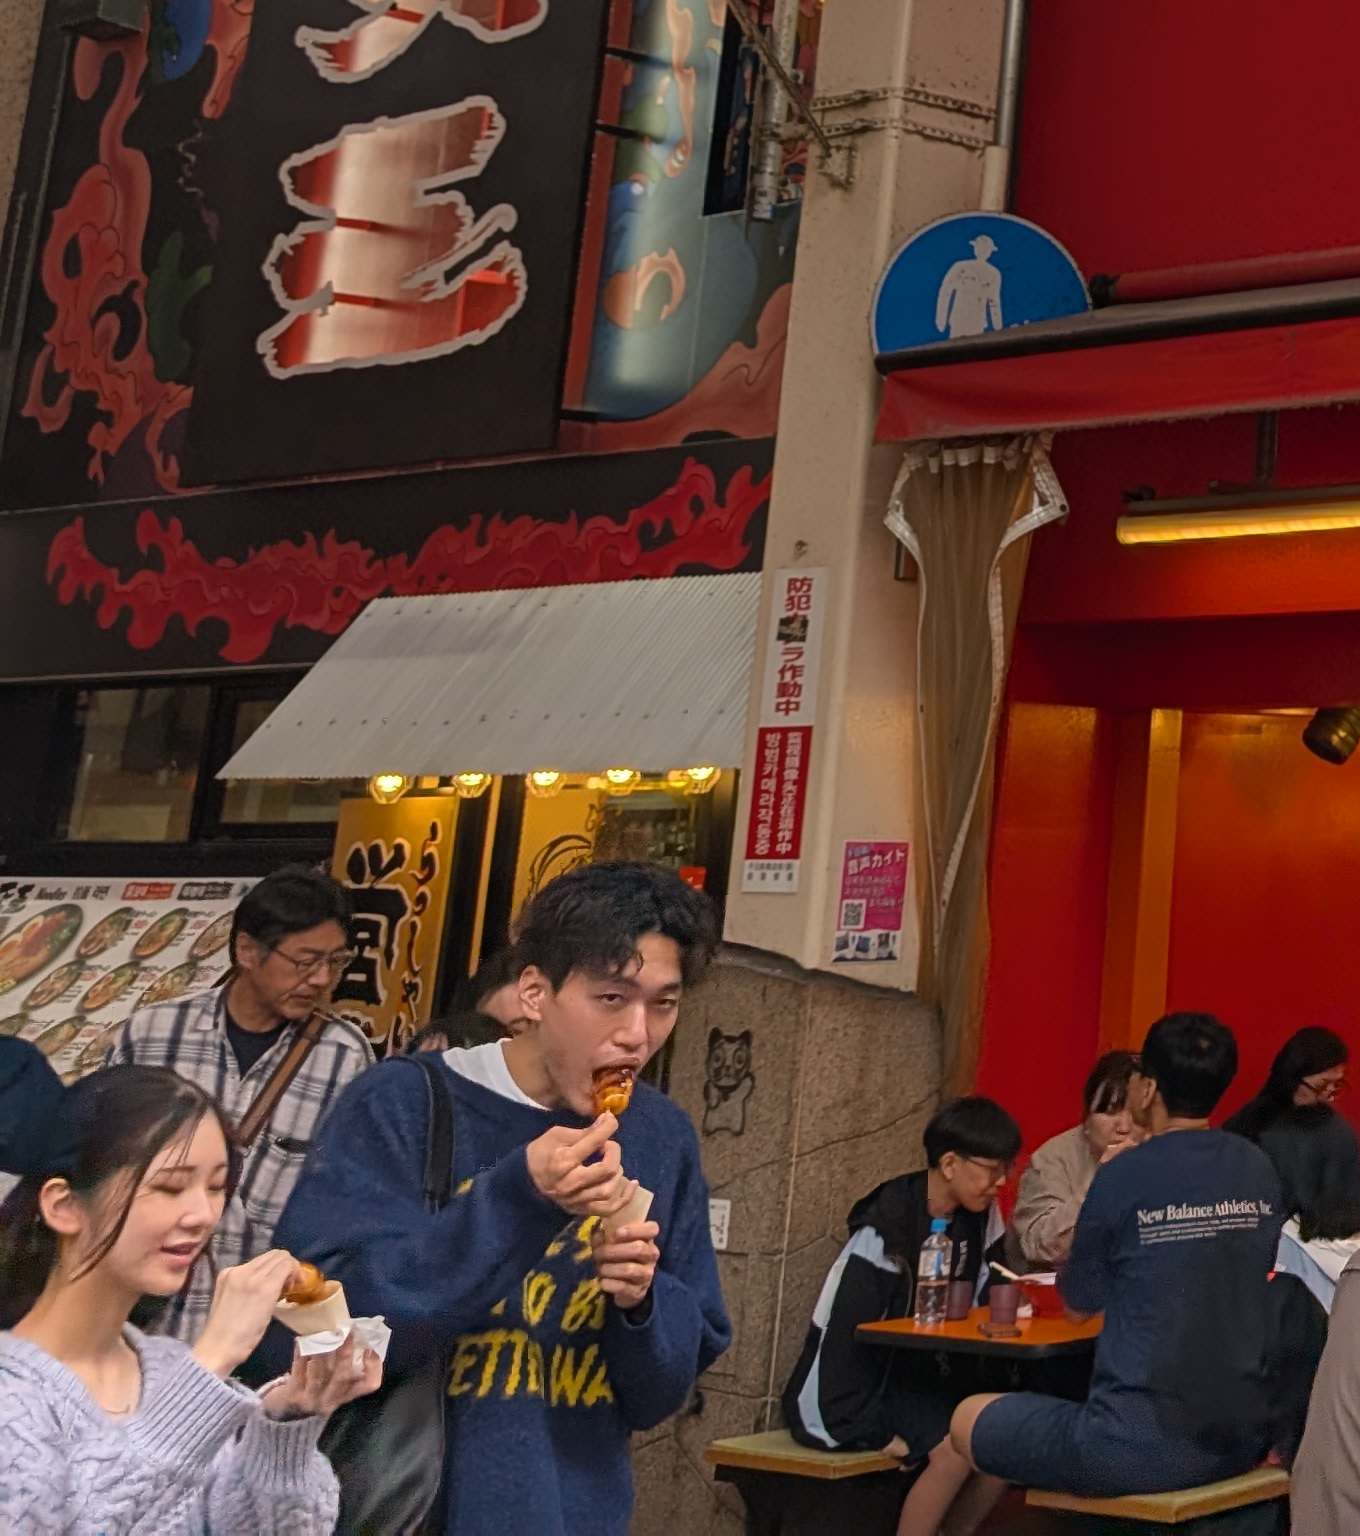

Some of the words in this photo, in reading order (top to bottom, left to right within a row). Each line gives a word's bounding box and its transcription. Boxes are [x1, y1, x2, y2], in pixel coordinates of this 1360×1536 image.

[775, 576, 814, 717] 防犯ラ作動中
[1137, 1208, 1165, 1225] New
[1166, 1202, 1213, 1221] Balance
[1215, 1199, 1259, 1216] Athletics,
